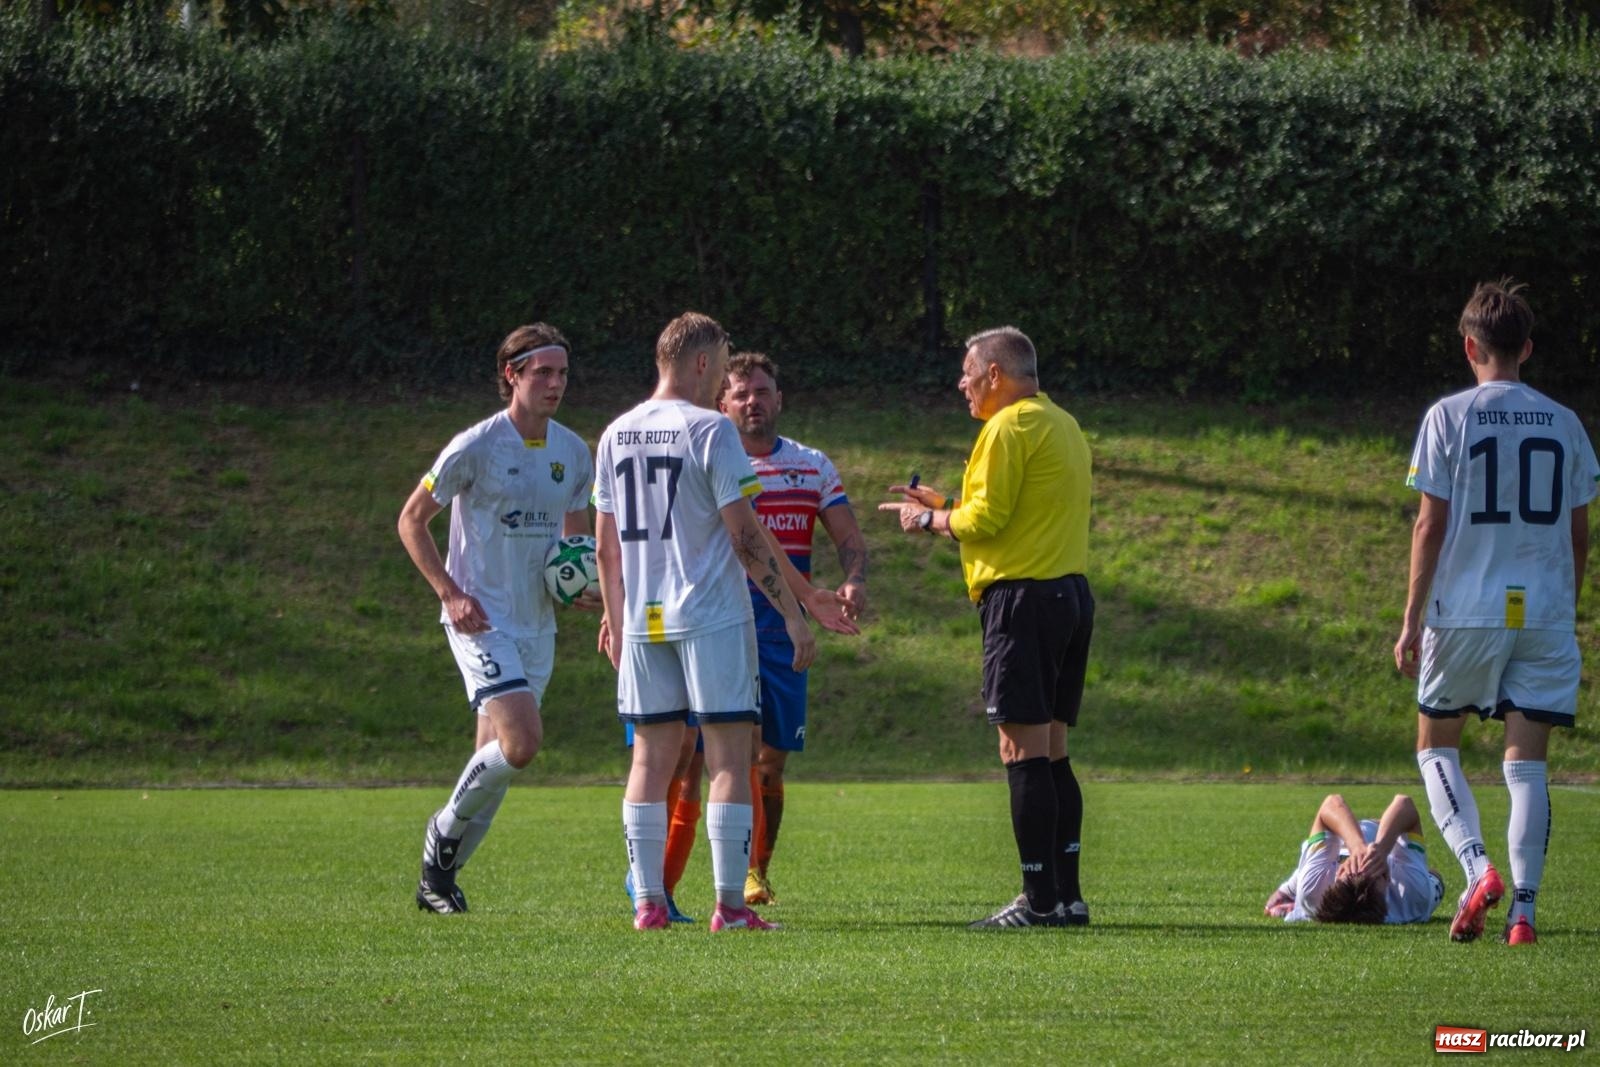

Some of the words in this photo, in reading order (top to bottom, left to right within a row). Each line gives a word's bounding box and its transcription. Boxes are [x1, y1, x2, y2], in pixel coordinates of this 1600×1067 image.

[1477, 411, 1509, 426] BUK
[1513, 411, 1554, 426] RUDY
[617, 430, 642, 445] BUK
[645, 430, 681, 445] RUDY
[1469, 436, 1565, 525] 10
[615, 455, 684, 542] 17
[478, 652, 502, 679] 5
